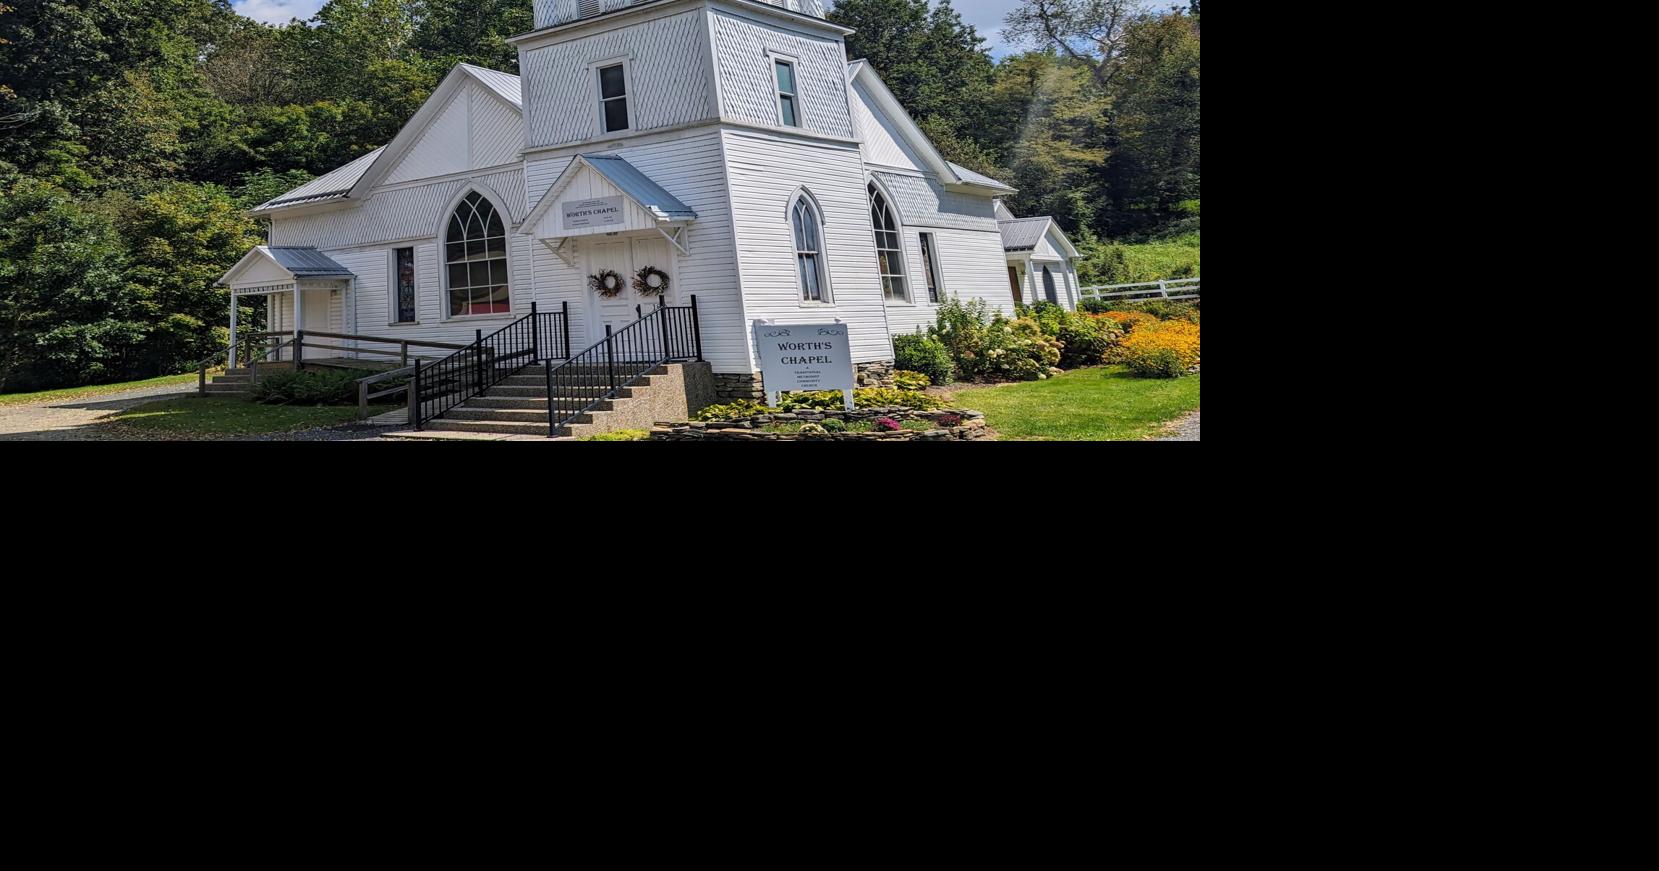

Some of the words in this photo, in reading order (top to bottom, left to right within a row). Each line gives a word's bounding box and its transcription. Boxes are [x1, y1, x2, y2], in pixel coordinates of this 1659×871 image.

[593, 207, 620, 215] CHAPEL
[778, 342, 832, 350] WORTH'S
[781, 356, 832, 364] CHAPEL
